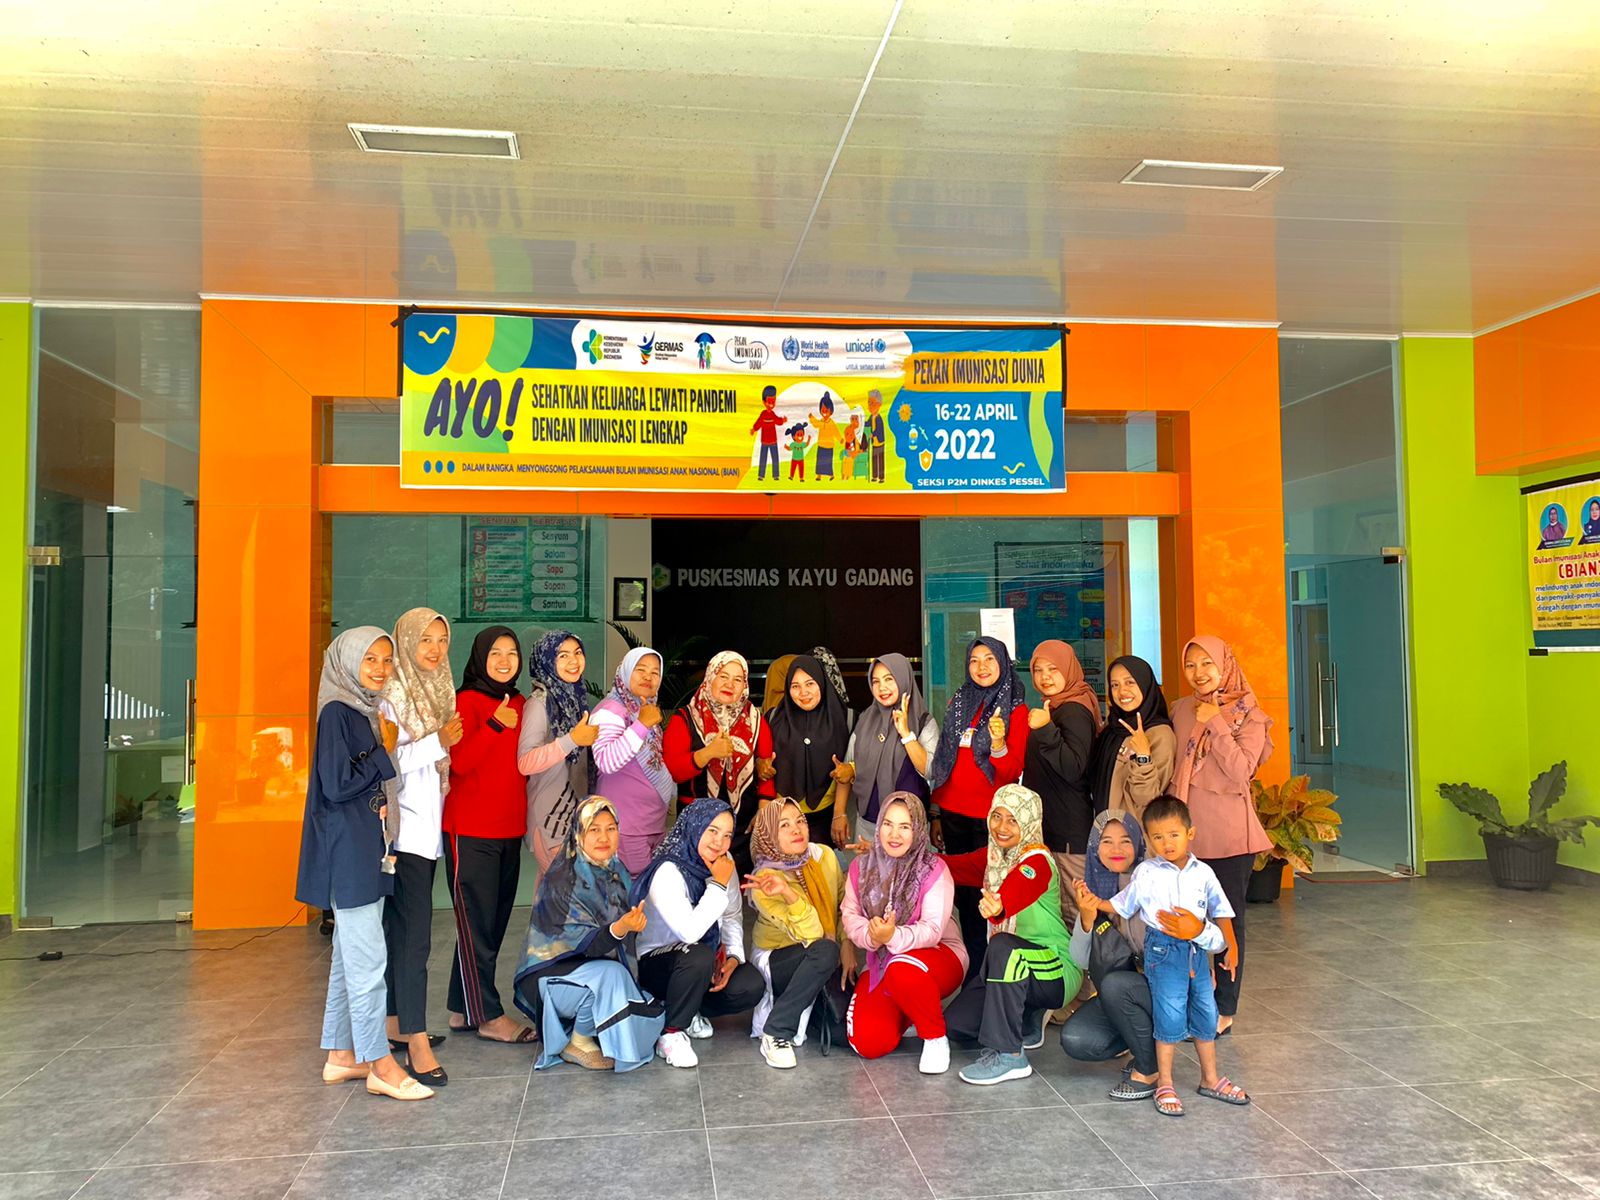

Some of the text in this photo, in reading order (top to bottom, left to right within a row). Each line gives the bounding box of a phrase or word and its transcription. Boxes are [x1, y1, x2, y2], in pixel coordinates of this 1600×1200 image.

[654, 342, 684, 352] GERMAS
[800, 340, 829, 350] World Health
[846, 338, 874, 352] unicef
[734, 348, 762, 358] IMUNISASI
[800, 350, 830, 360] Organization
[914, 358, 1046, 385] PEKAN IMUNISASI DUNIA
[532, 383, 737, 414] SEHATKAN KELUARGA LEWATI PANDEMI
[424, 377, 524, 442] AYO!
[935, 403, 1018, 422] 16-22 APRIL
[532, 417, 688, 445] DENGAN IMUNISASI LENGKAP
[934, 428, 996, 460] 2022
[462, 463, 740, 478] DALAM RANGKA MENYONGSONG PELAKSANAAN BULAN IMUNISASI ANAK NASIONAL (BIAN)
[917, 477, 1045, 488] SEKSI P2M DINKES PESSEL
[542, 531, 569, 542] Senyum
[544, 550, 566, 559] Salam
[547, 565, 564, 575] Sapa
[678, 568, 914, 587] PUSKESMAS KAYU GADANG
